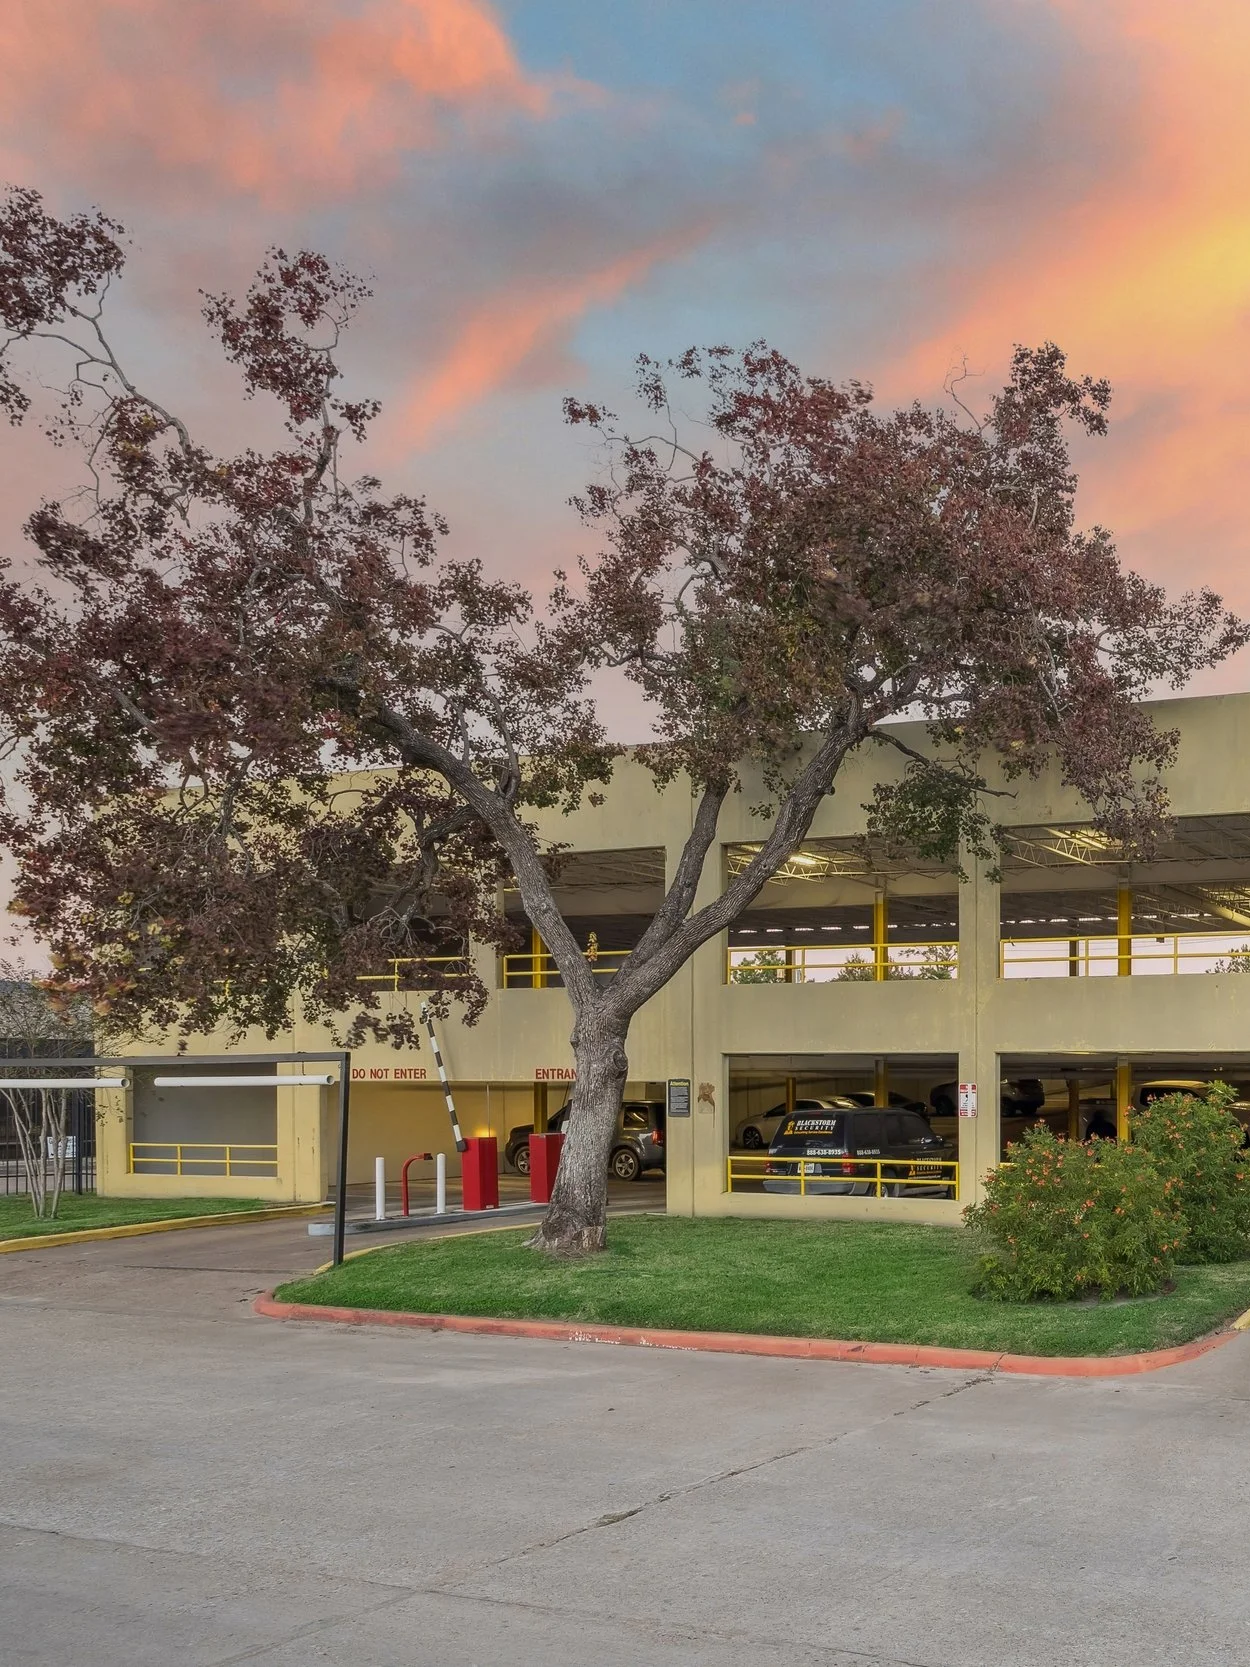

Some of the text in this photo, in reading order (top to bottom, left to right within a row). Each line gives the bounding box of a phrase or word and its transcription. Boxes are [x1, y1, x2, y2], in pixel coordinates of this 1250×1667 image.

[352, 1068, 427, 1079] DO NOT ENTER
[796, 1119, 836, 1127] BLACKSTORM
